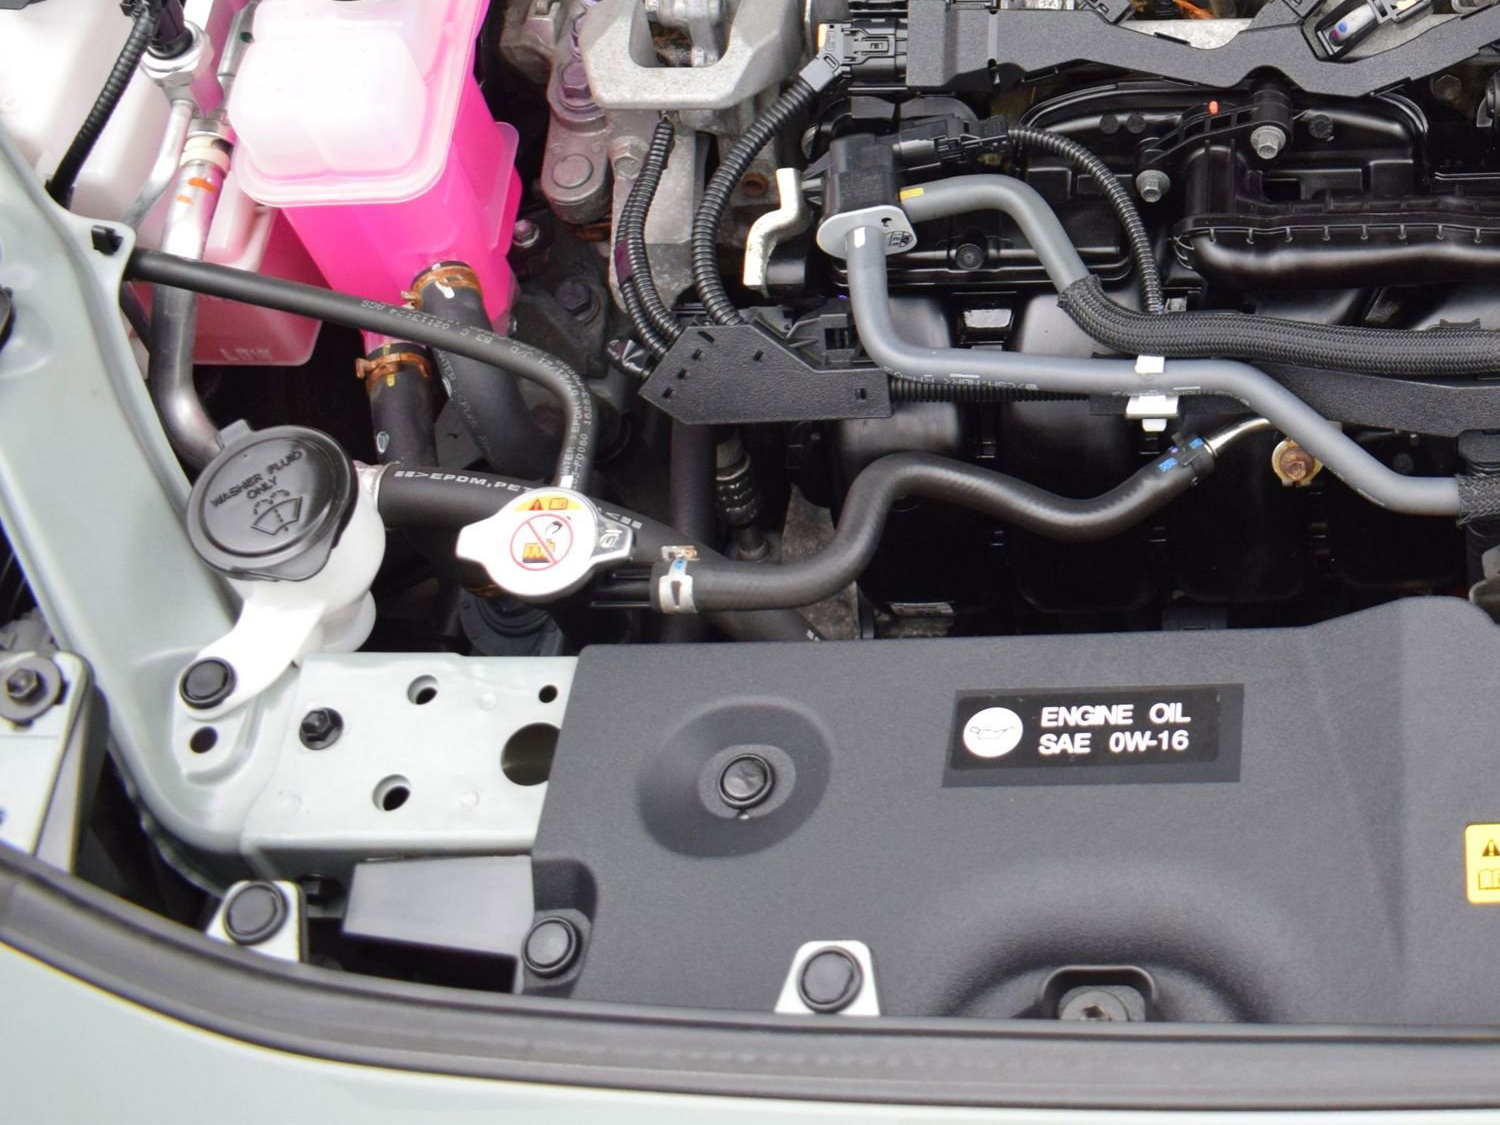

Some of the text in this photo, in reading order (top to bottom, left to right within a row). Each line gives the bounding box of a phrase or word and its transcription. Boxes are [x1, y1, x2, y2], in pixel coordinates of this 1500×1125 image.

[210, 450, 303, 508] WASHER FLUID
[246, 476, 277, 500] ONLY
[1040, 702, 1191, 728] ENGINE OIL
[1038, 729, 1190, 755] SAE 0W-16
